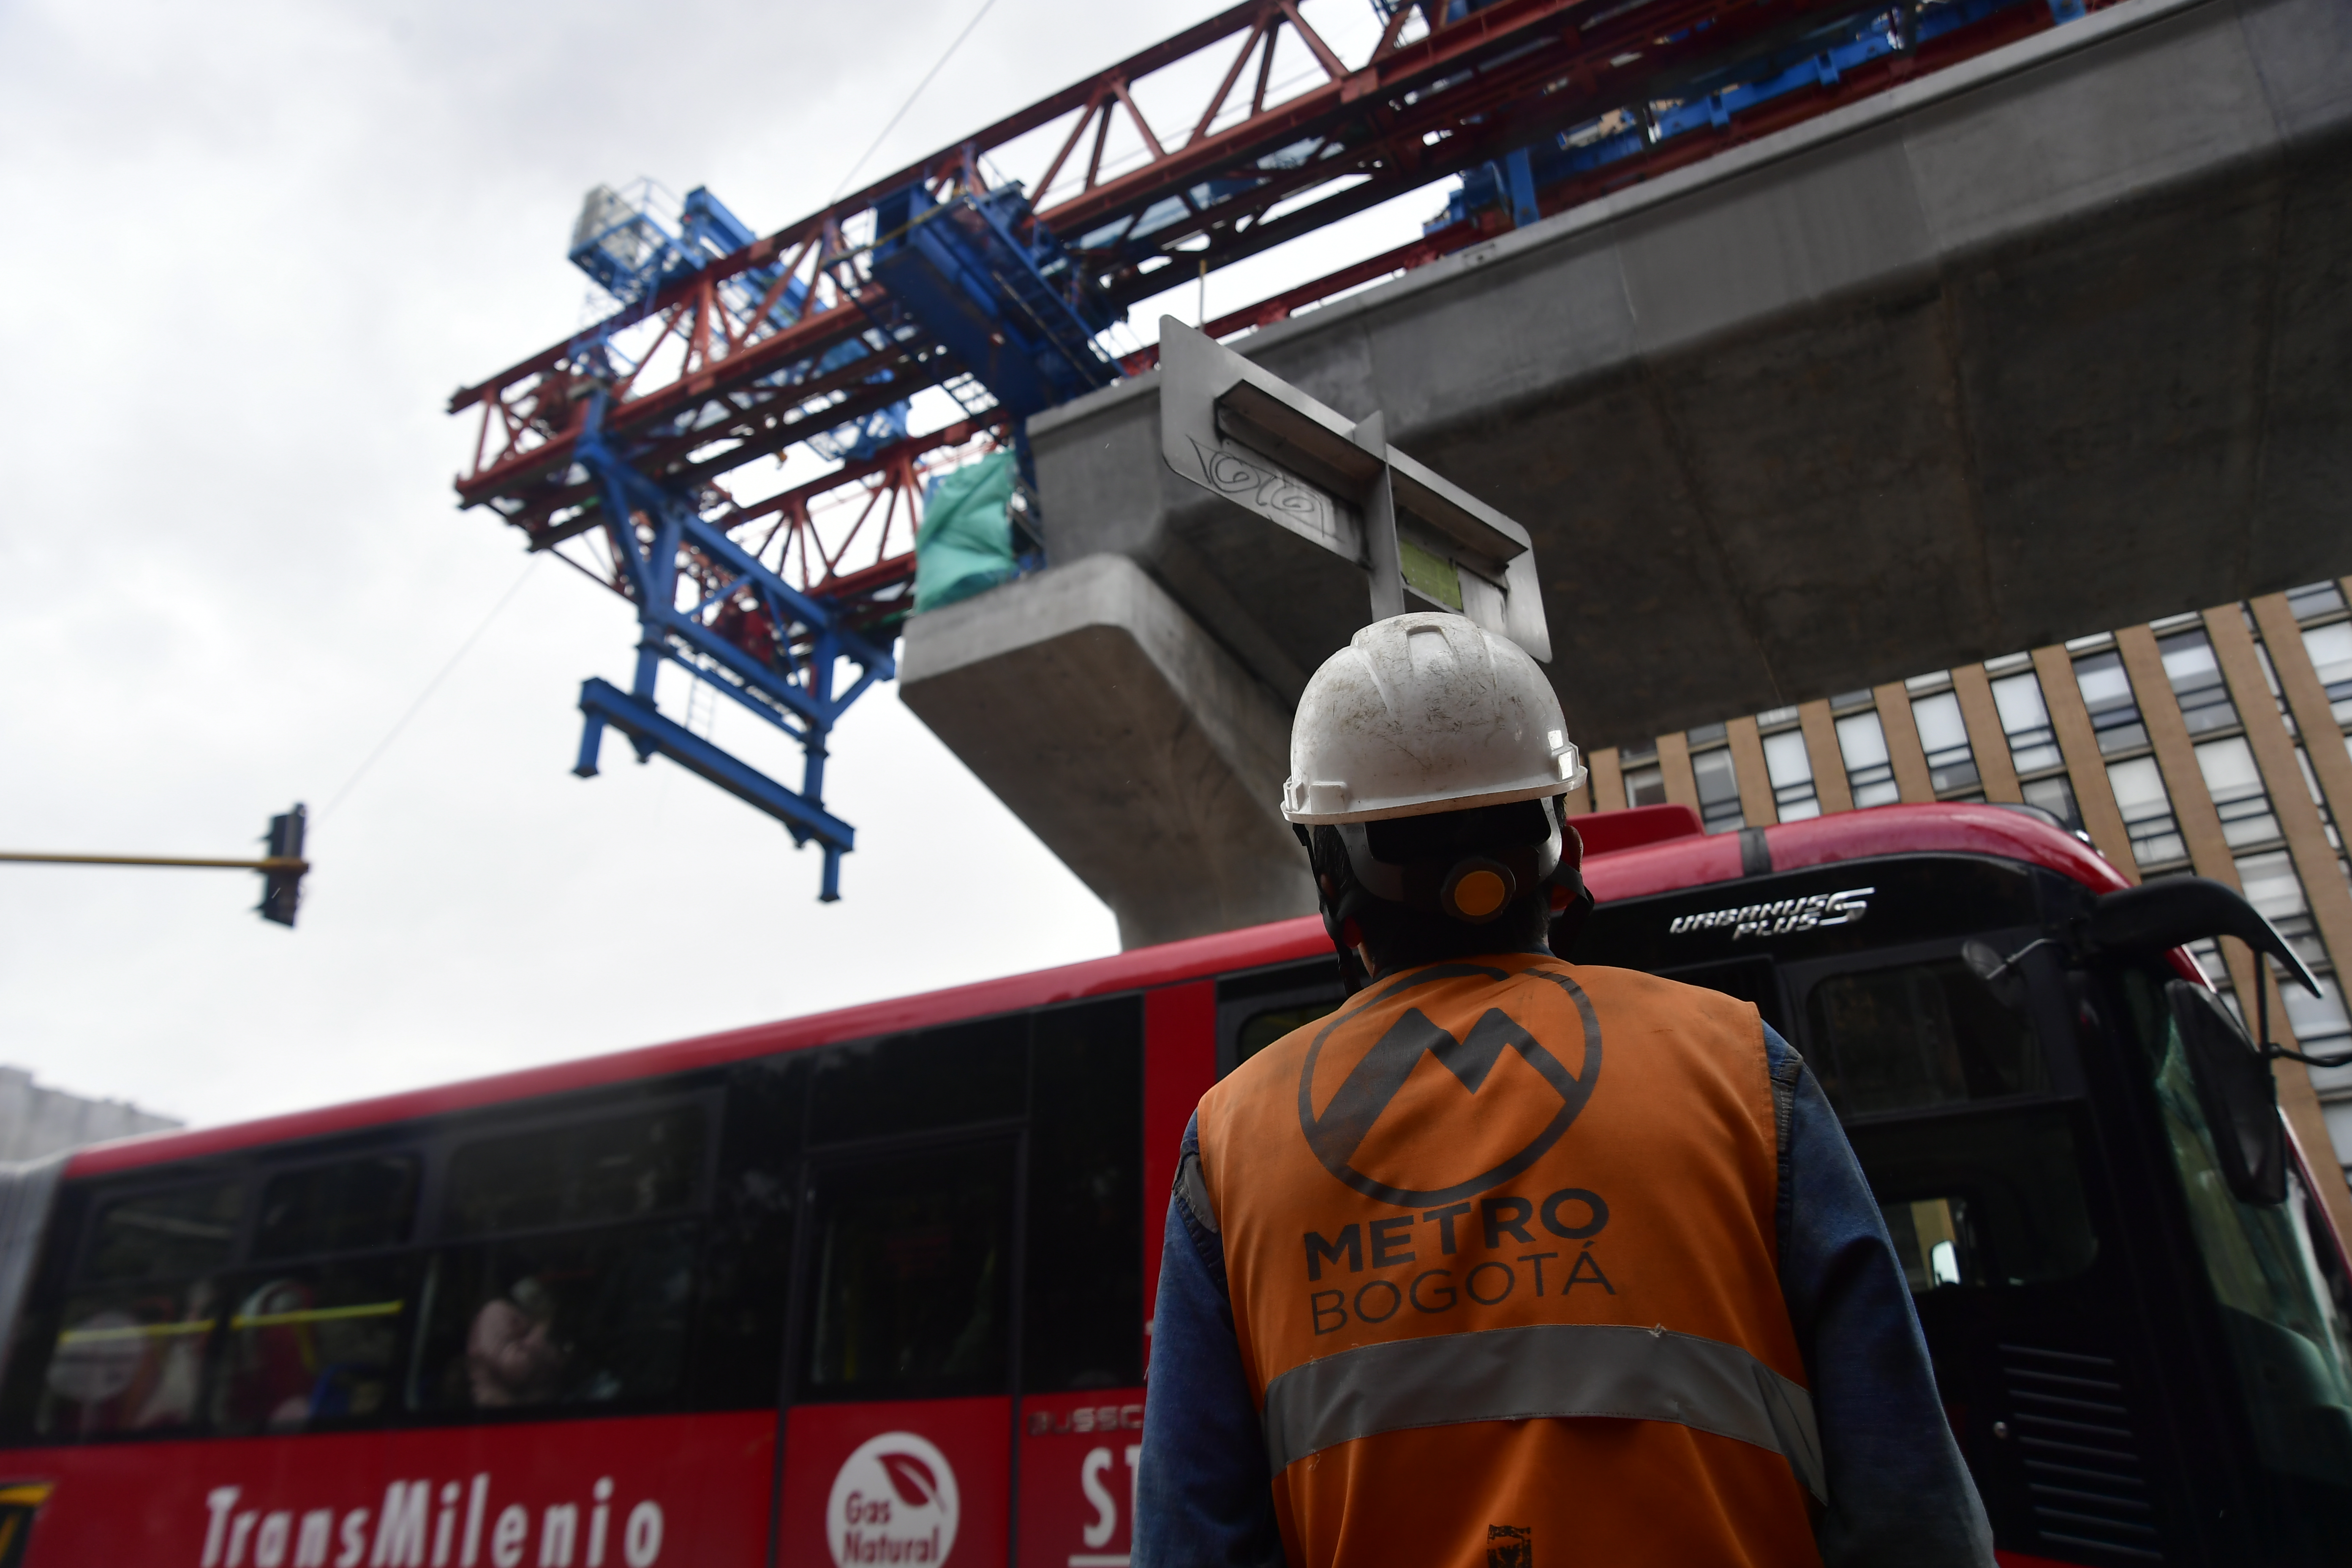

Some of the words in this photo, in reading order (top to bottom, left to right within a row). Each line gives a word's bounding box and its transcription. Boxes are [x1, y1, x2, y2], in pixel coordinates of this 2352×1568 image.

[1304, 1188, 1609, 1282] METRO
[1311, 1240, 1616, 1336] BOGOTÁ
[200, 1471, 664, 1568] TransMilenio
[843, 1523, 939, 1564] Natural
[846, 1490, 891, 1525] Gas
